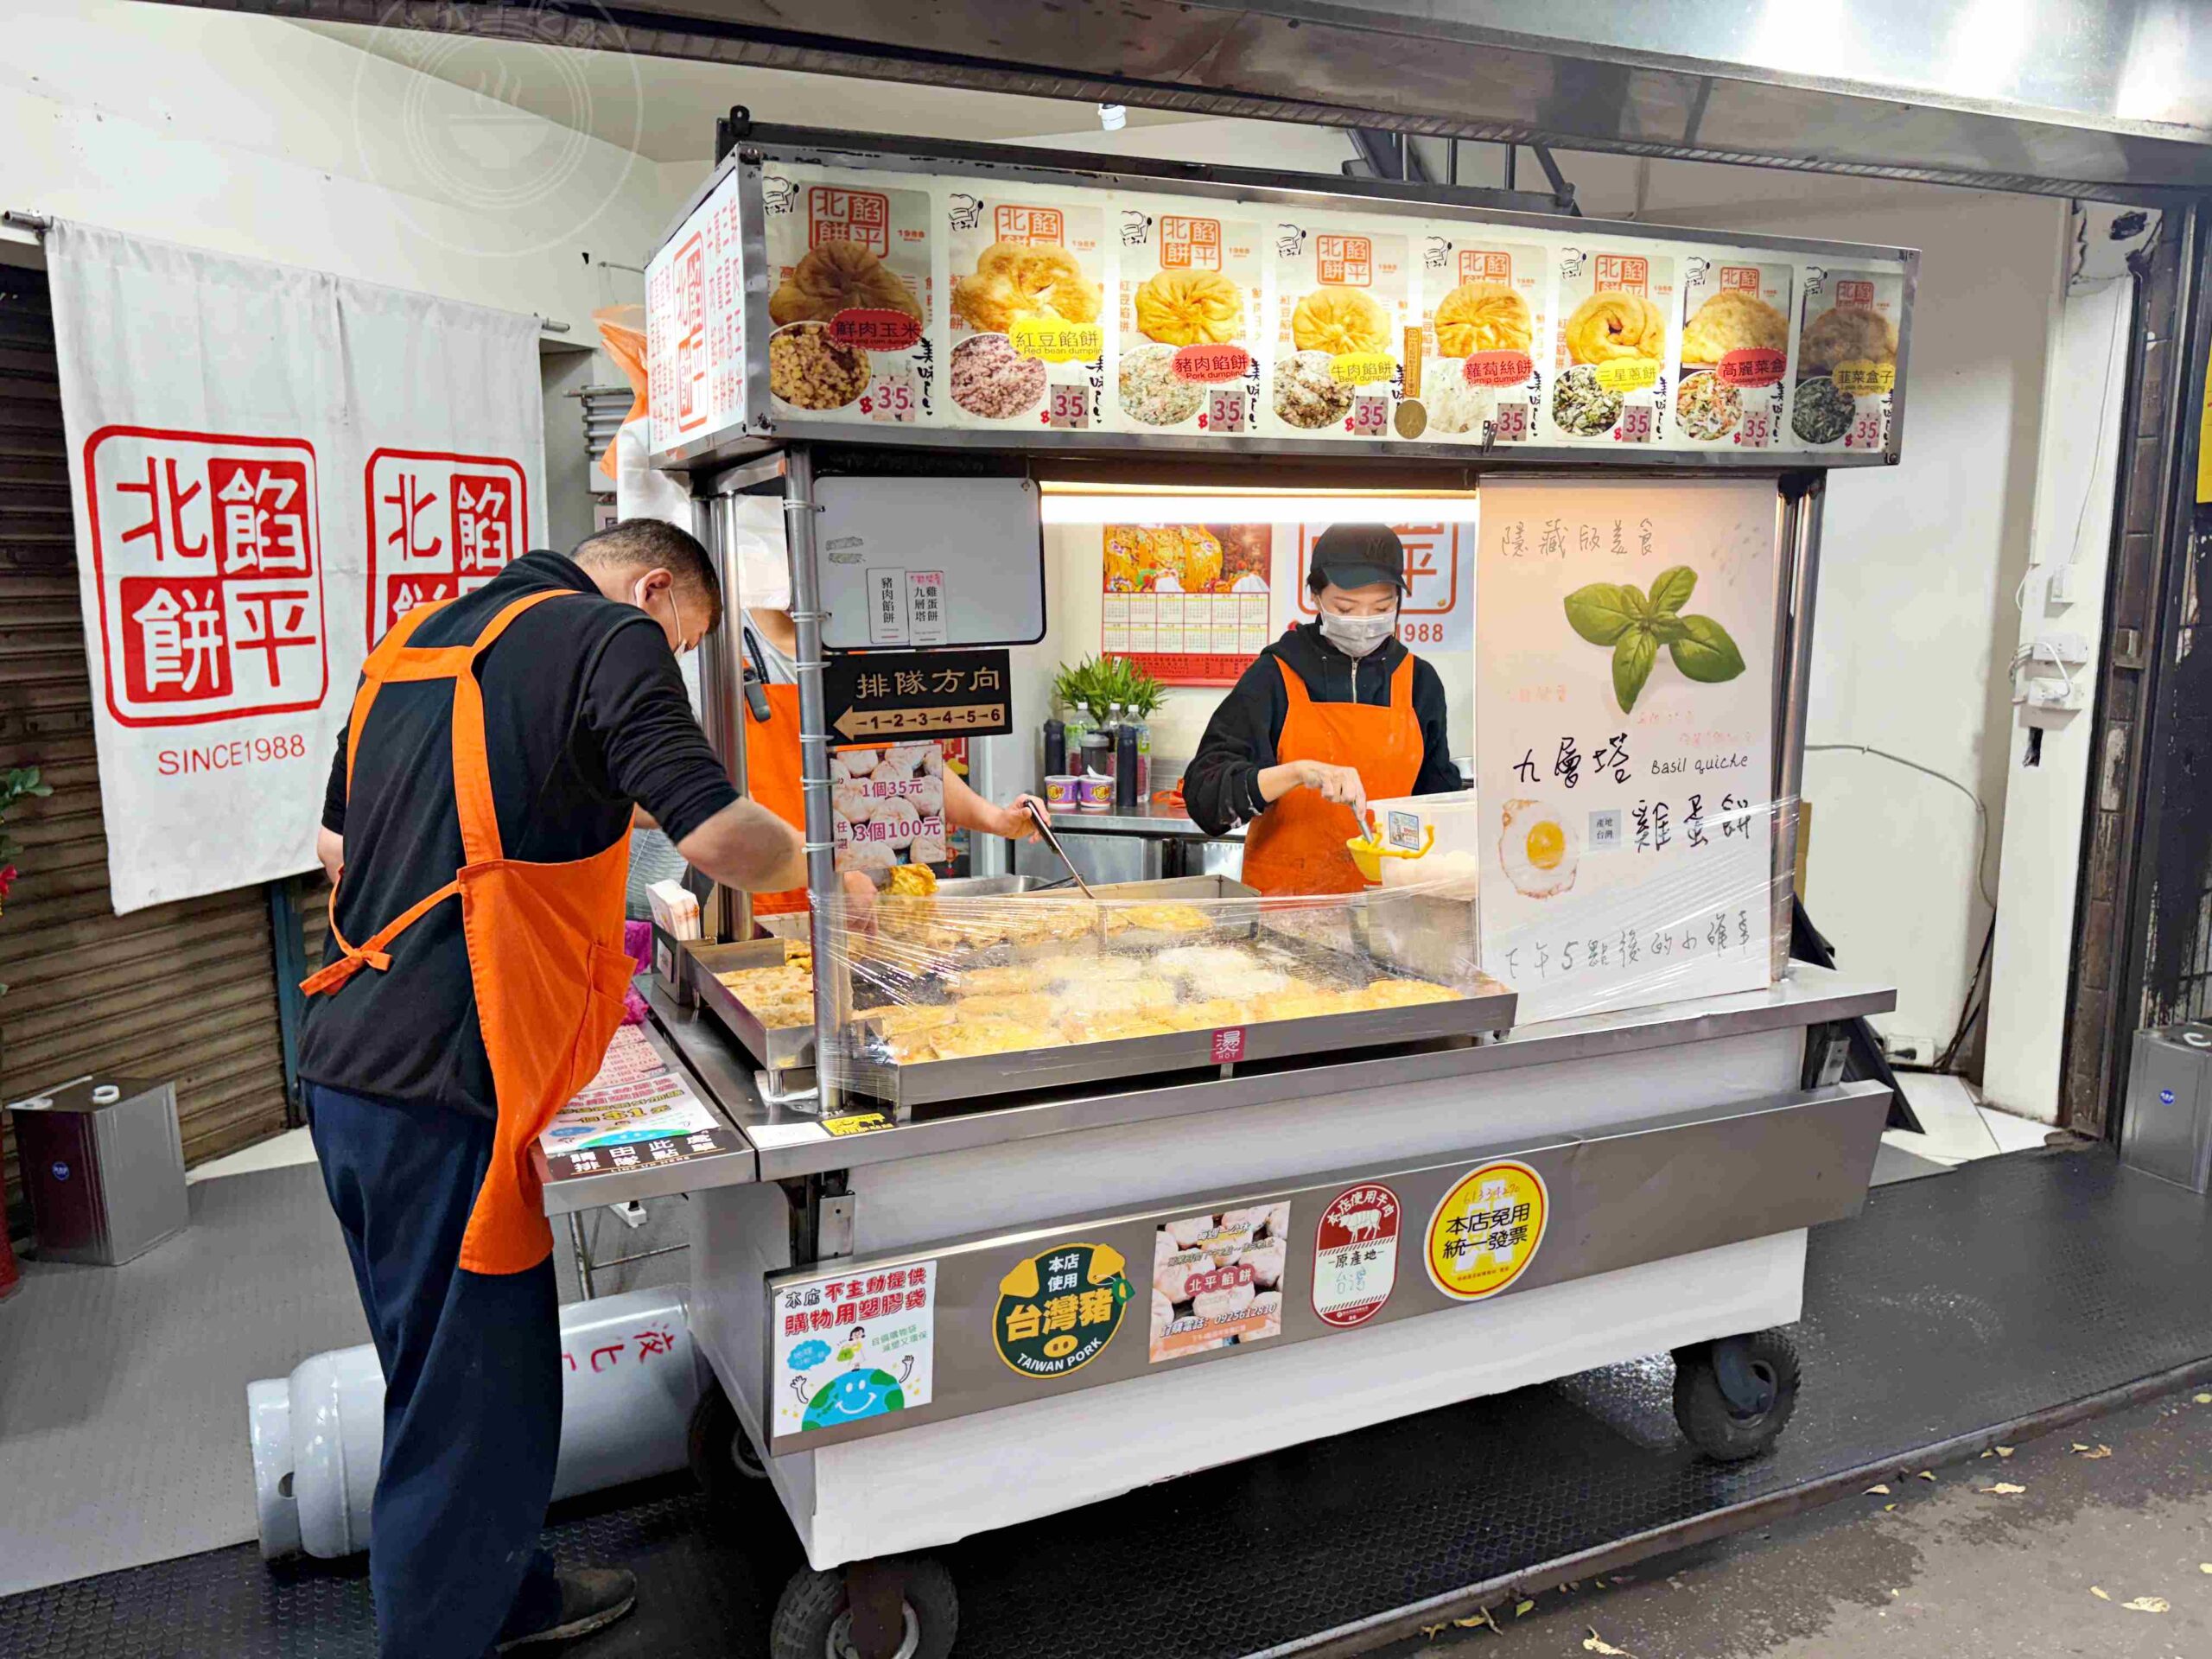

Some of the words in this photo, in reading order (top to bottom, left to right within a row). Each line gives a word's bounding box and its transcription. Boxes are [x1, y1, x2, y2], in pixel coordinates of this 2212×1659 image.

[1015, 331, 1098, 347] 紅豆餡餅
[1175, 354, 1248, 372] 豬肉餡餅
[1185, 371, 1205, 379] Pork
[1331, 361, 1392, 377] 牛肉餡餅
[880, 576, 895, 624] 豬肉餡餅
[855, 666, 1001, 699] 排隊方向
[1512, 733, 1631, 789] 九層塔
[1651, 757, 1688, 775] Basil
[861, 779, 924, 798] 1個35元
[855, 817, 941, 842] 3個100元
[1326, 1190, 1395, 1226] 本店使用牛肉
[1445, 1202, 1530, 1236] 本店免用
[1442, 1224, 1529, 1259] 統一發票
[1048, 1253, 1080, 1273] 本店
[1047, 1273, 1078, 1293] 使用
[1189, 1268, 1253, 1293] 北平餡餅
[785, 1287, 927, 1336] 購物用塑膠袋
[1006, 1287, 1114, 1343] 台灣豬
[1016, 1352, 1065, 1372] TAIWAN
[1066, 1337, 1103, 1367] PORK
